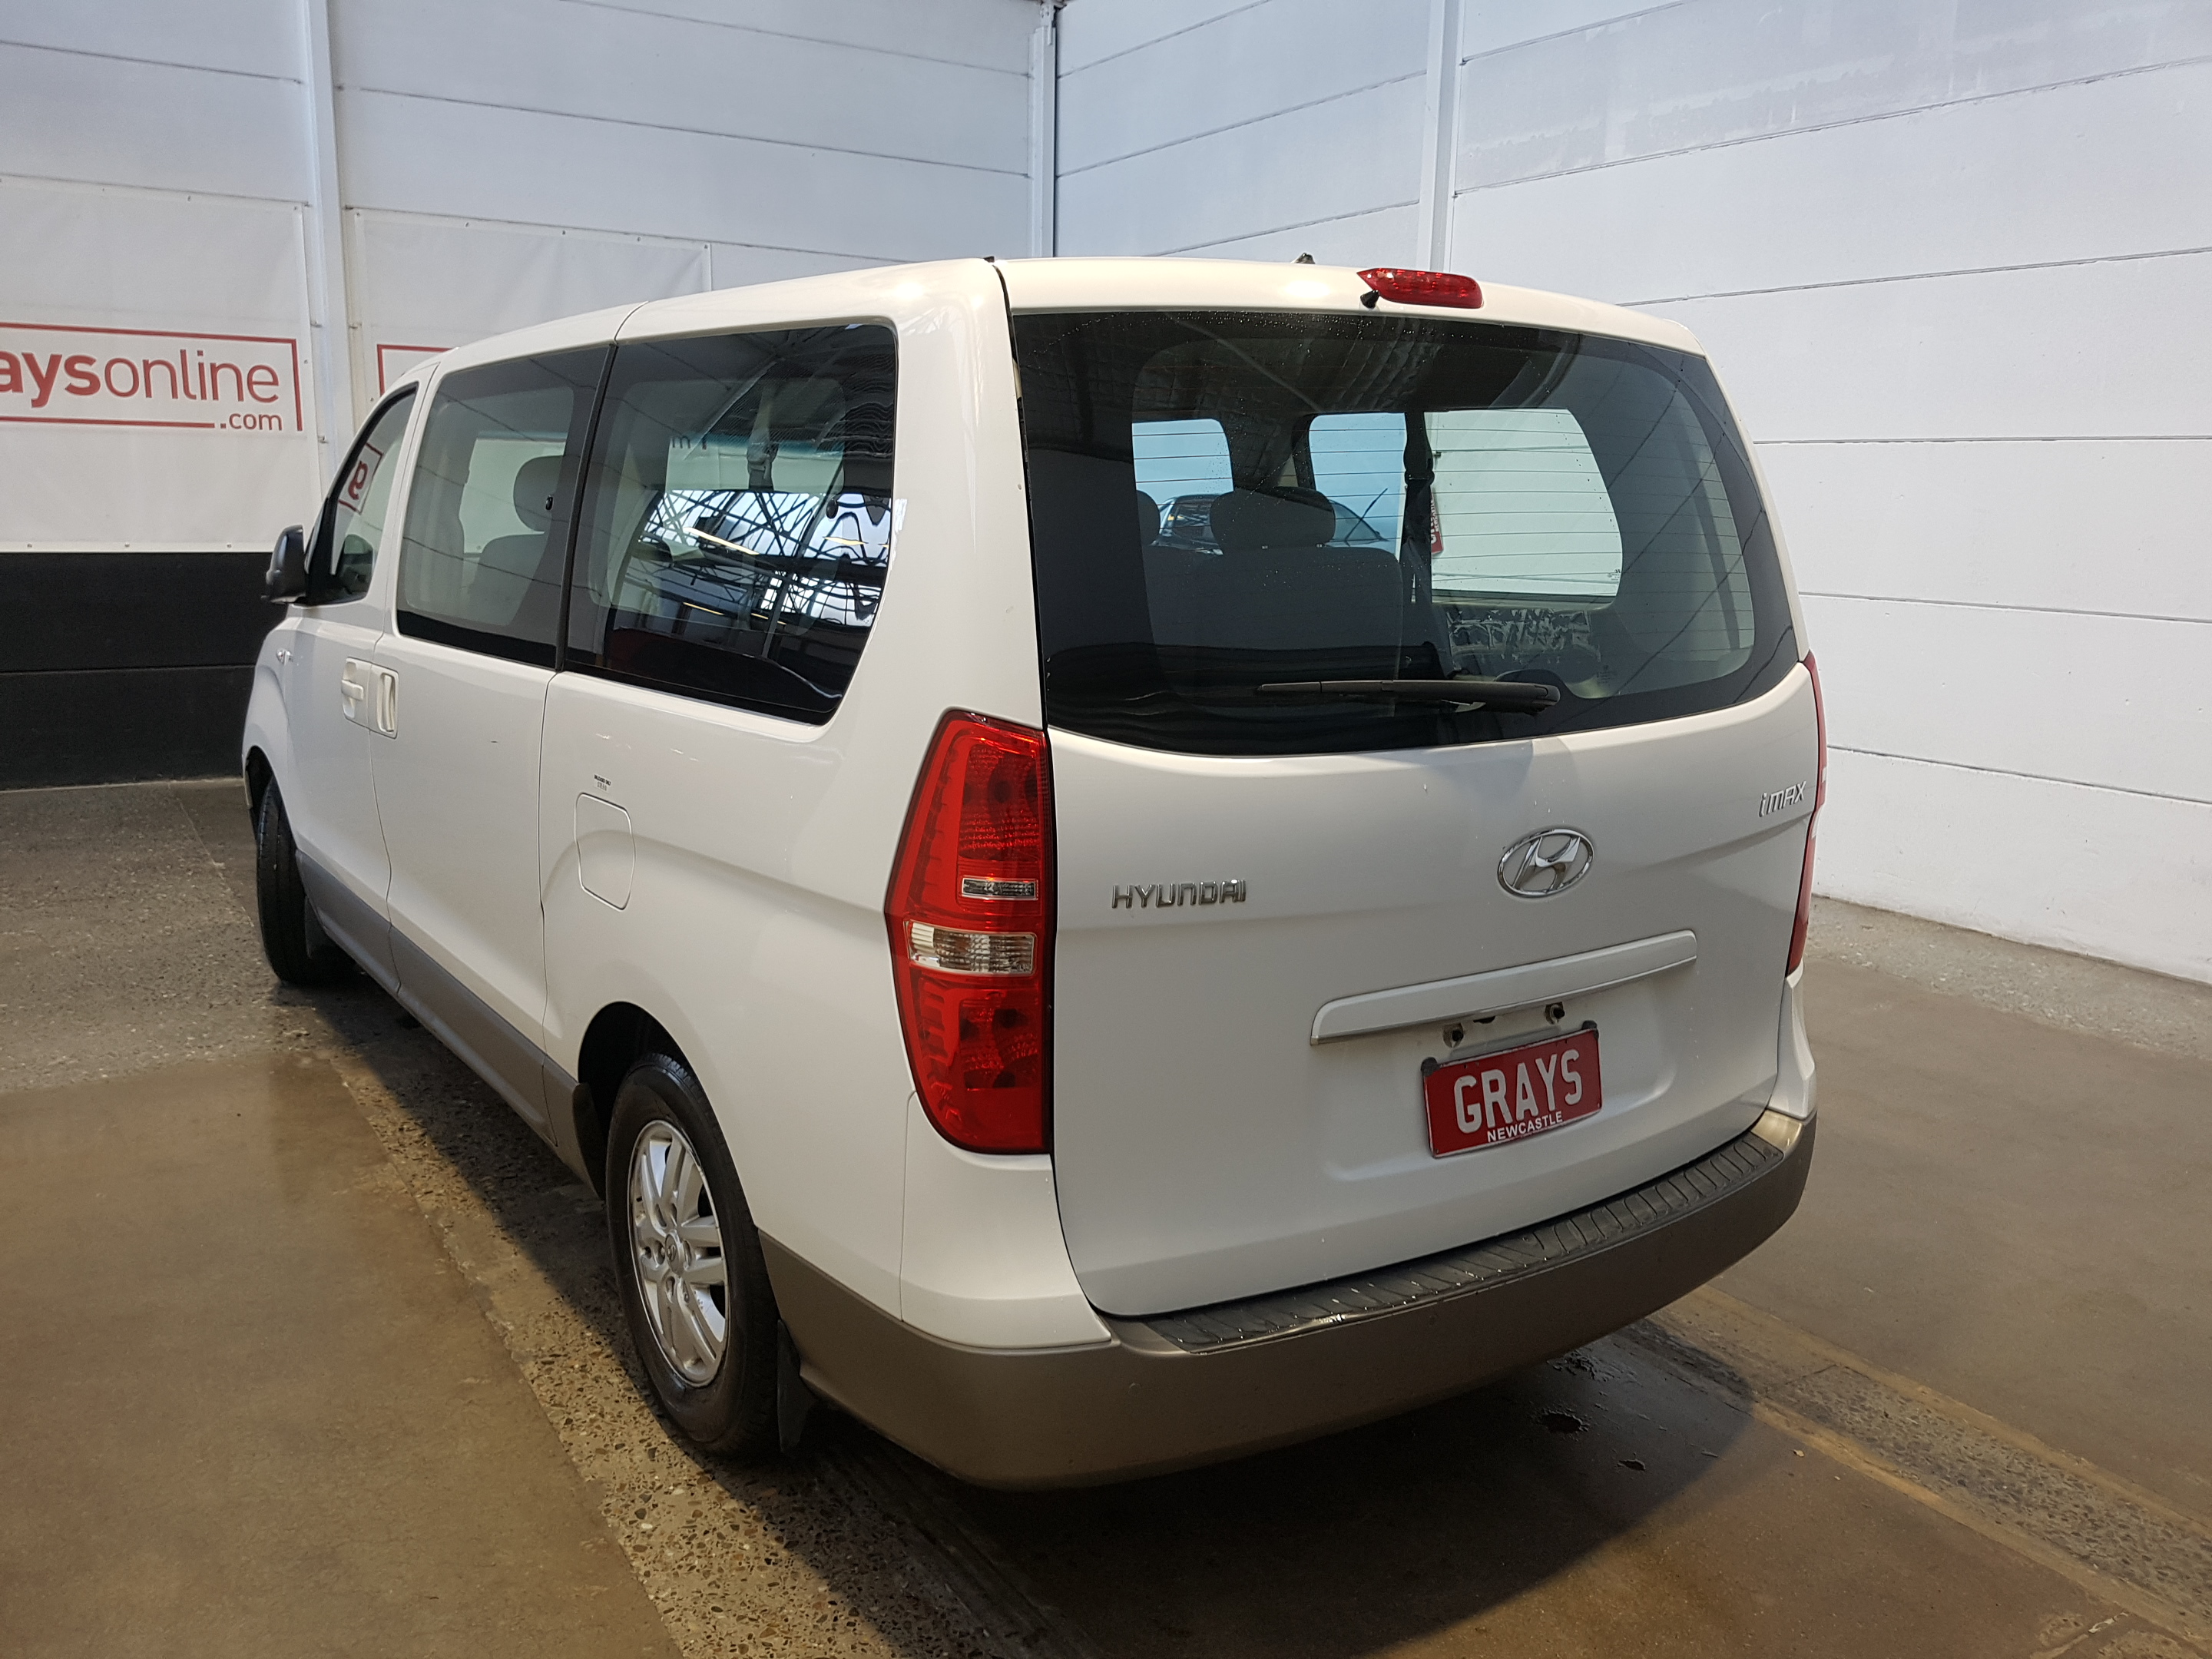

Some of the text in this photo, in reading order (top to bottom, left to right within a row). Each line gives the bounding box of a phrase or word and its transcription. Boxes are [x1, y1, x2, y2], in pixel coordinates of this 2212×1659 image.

[220, 412, 283, 431] .com
[1112, 879, 1247, 909] HYUNDAI
[1454, 1049, 1582, 1134] GRAYS
[1487, 1111, 1563, 1143] NEWCASTLE
